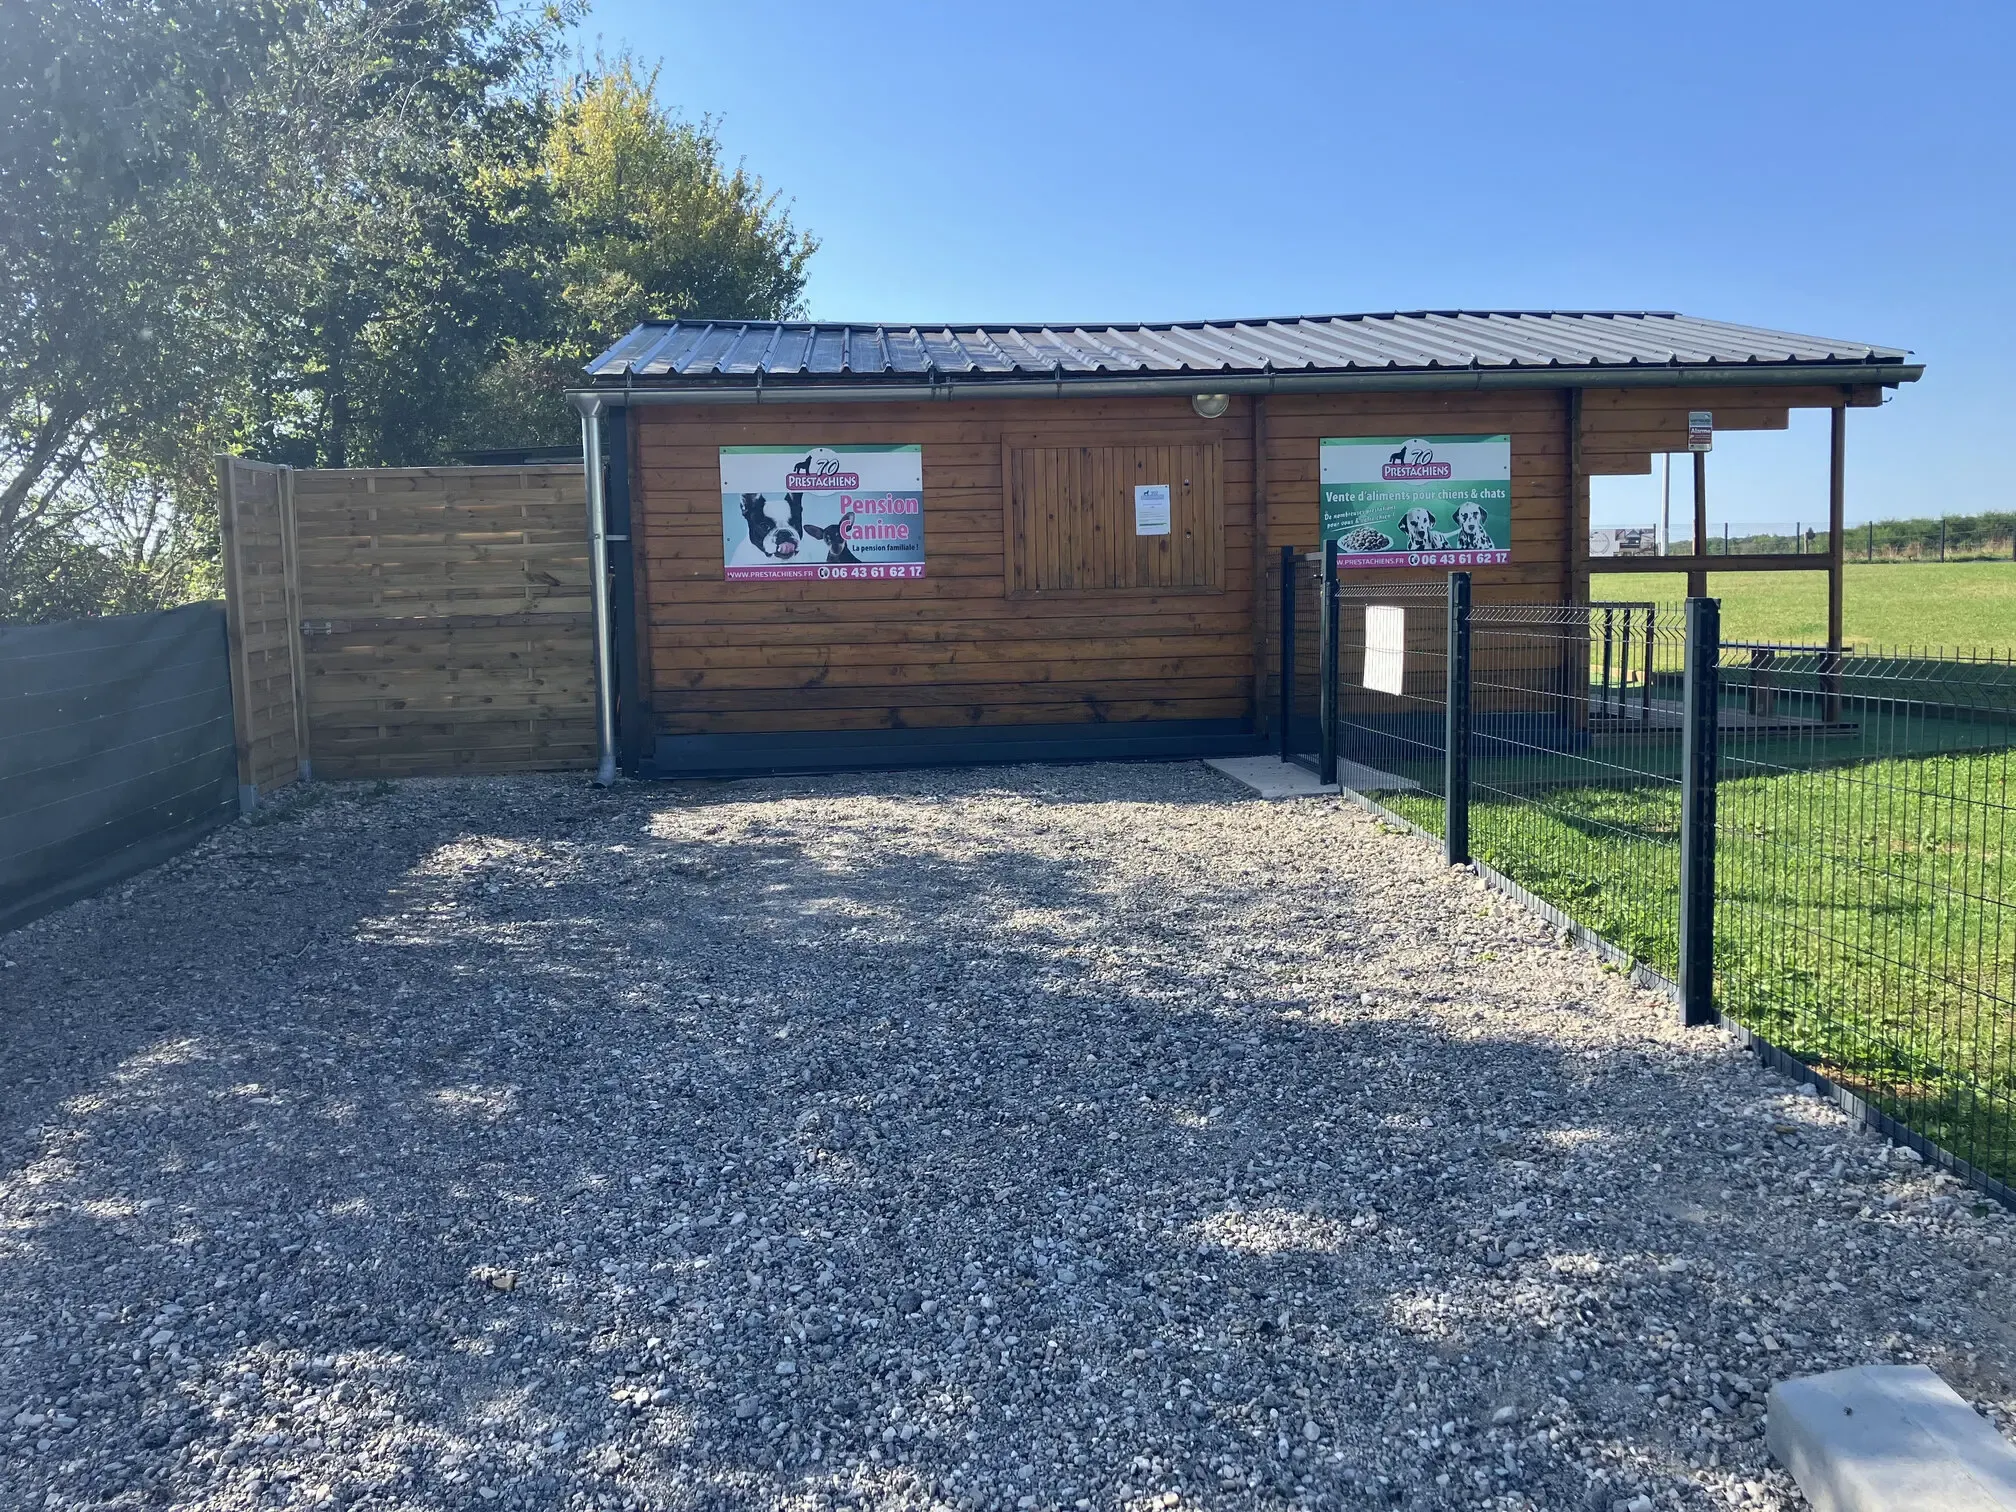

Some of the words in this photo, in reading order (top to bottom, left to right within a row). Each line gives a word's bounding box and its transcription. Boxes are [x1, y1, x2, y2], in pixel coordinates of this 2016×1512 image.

[1410, 449, 1433, 465] 70
[816, 459, 840, 476] 70
[1384, 465, 1449, 477] PRESTACHIENS
[788, 475, 857, 488] PRESTACHIENS
[1325, 491, 1356, 502] Vente
[1412, 489, 1436, 502] pour
[1438, 488, 1469, 500] chiens
[1471, 488, 1478, 499] &
[1480, 487, 1506, 499] chats
[839, 493, 919, 515] Pension
[839, 519, 910, 541] Canine
[852, 544, 860, 552] La
[861, 544, 886, 553] pension
[1337, 558, 1404, 566] W.PRESTACHIENS.FR
[1421, 555, 1437, 565] 06
[1440, 554, 1456, 564] 43
[1459, 554, 1472, 564] 61
[1476, 553, 1492, 564] 62
[1495, 553, 1508, 563] 17
[831, 568, 848, 578] 06
[851, 567, 867, 578] 43
[871, 567, 885, 577] 61
[889, 567, 906, 577] 62
[909, 566, 922, 577] 17
